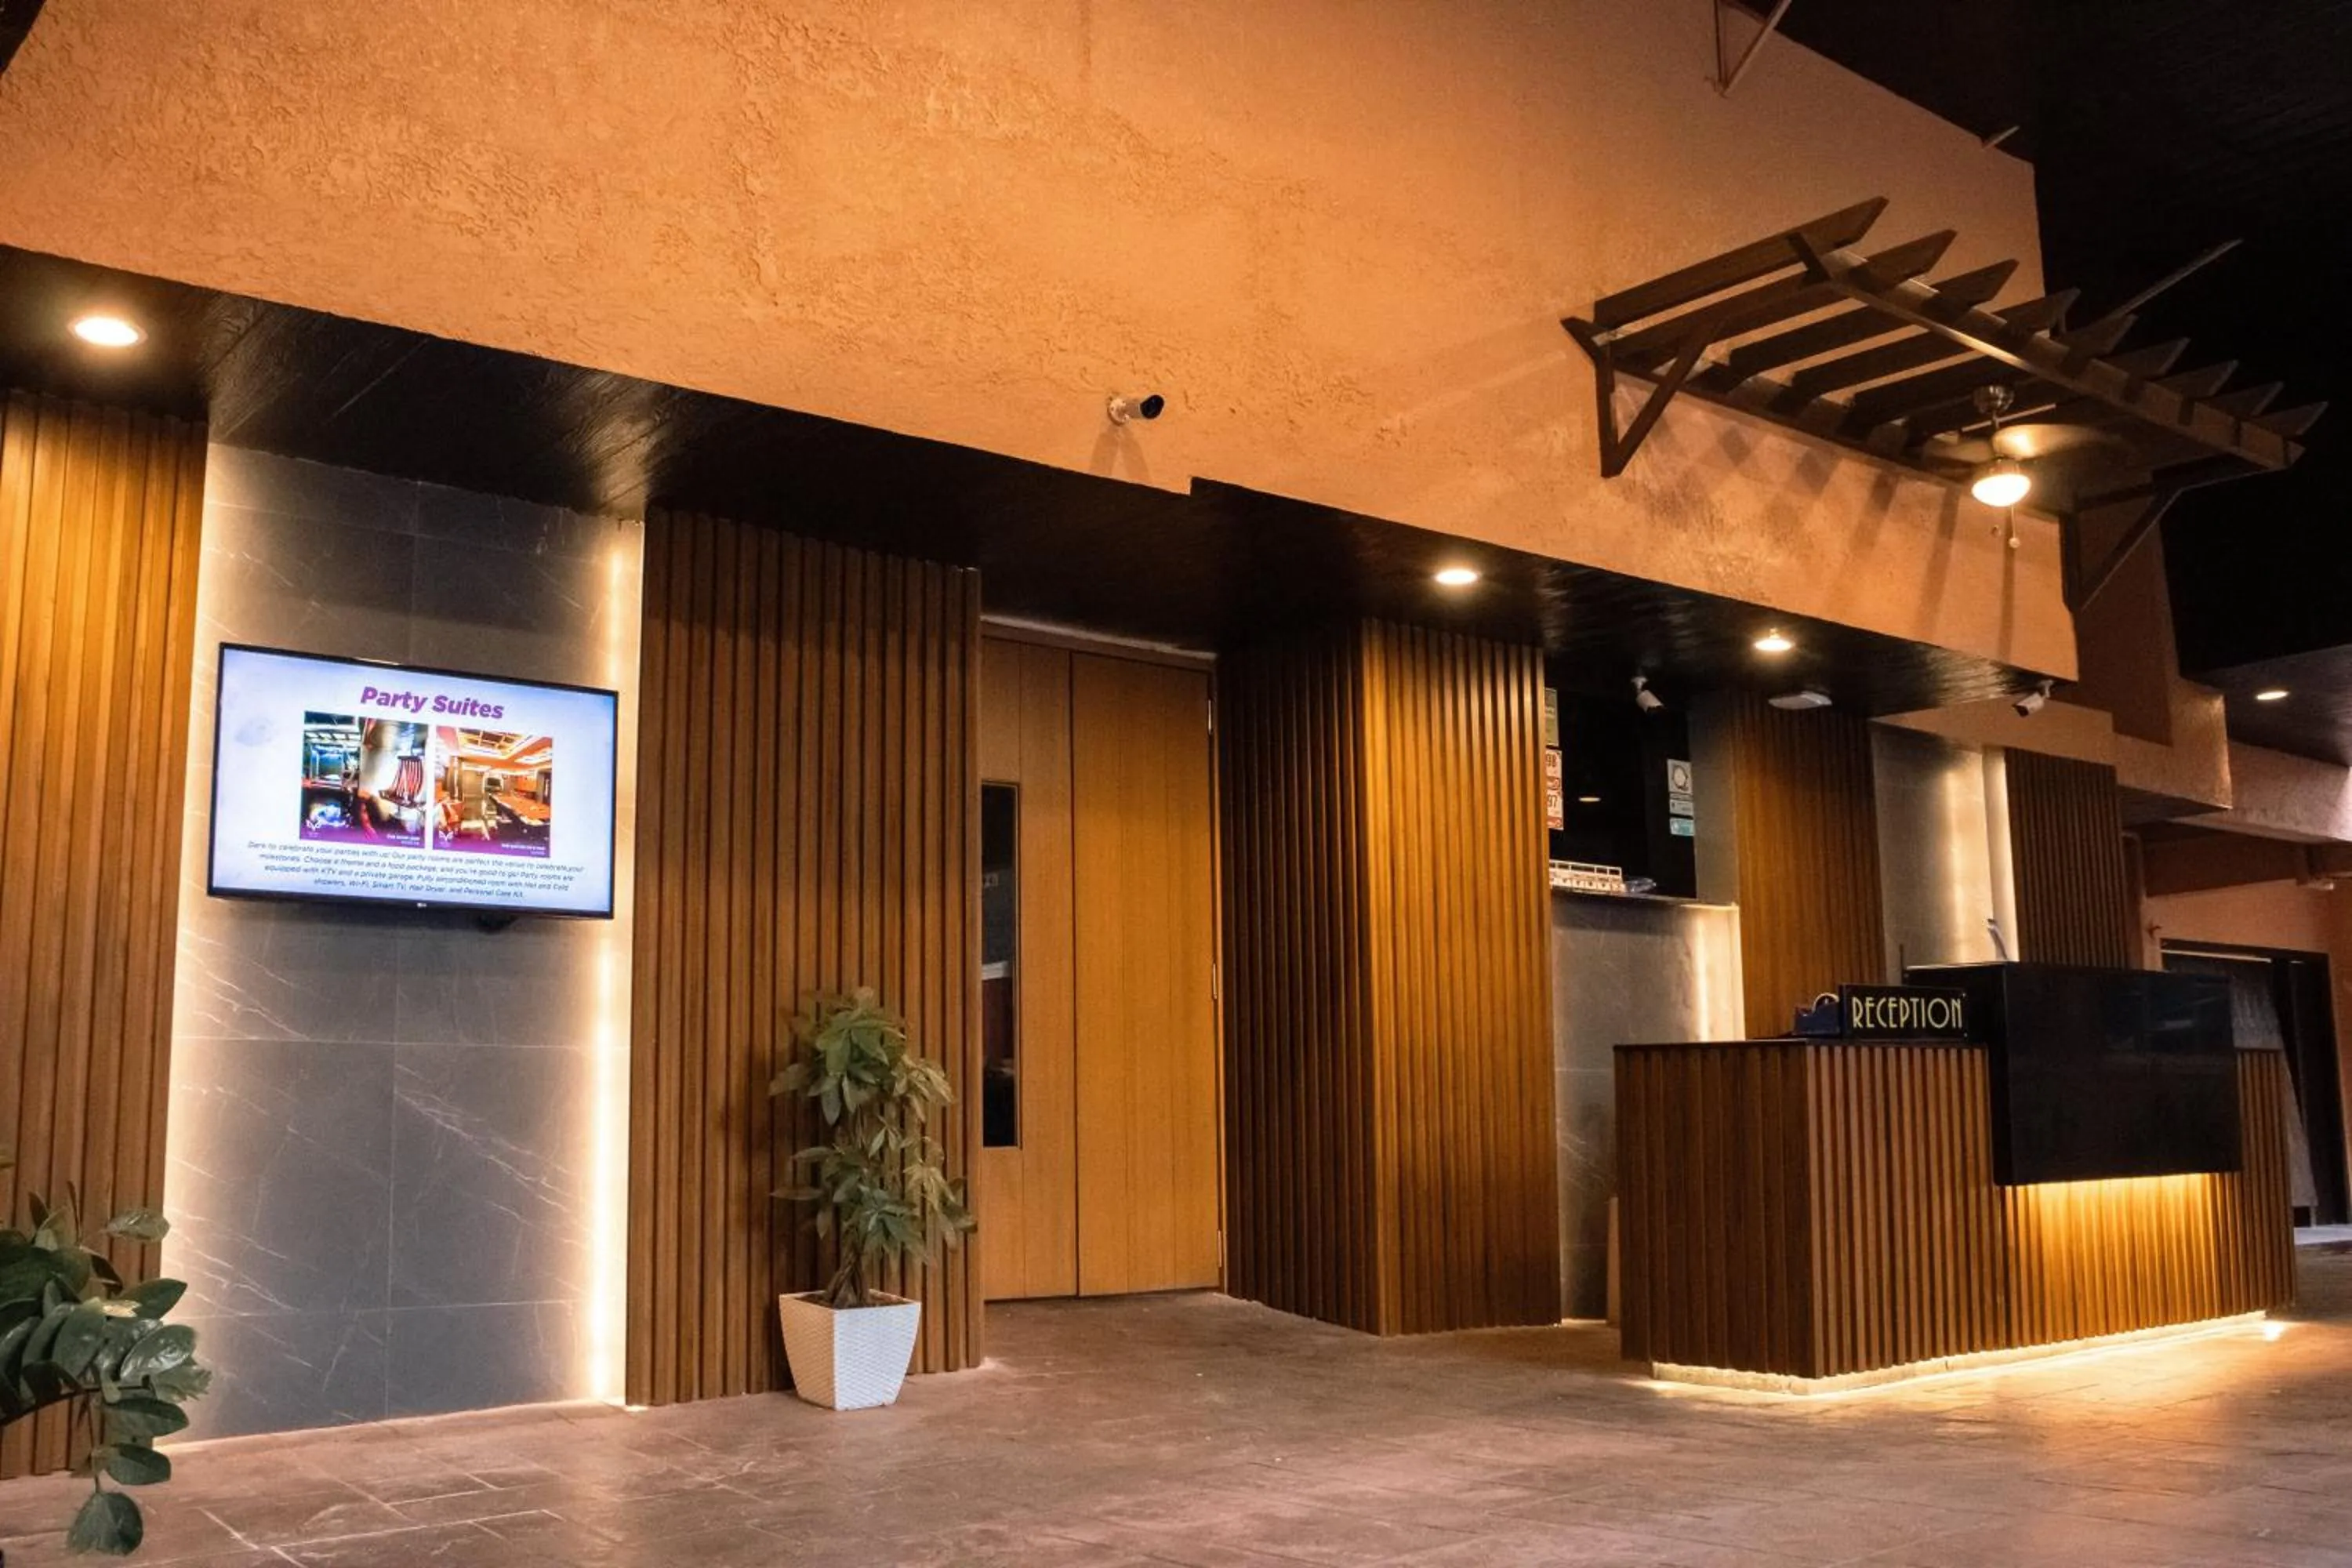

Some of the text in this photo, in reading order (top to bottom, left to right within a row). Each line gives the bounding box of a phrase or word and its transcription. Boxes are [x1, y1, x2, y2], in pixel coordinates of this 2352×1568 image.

[361, 686, 504, 719] Party Suites
[1852, 996, 1962, 1029] RECEPTION
